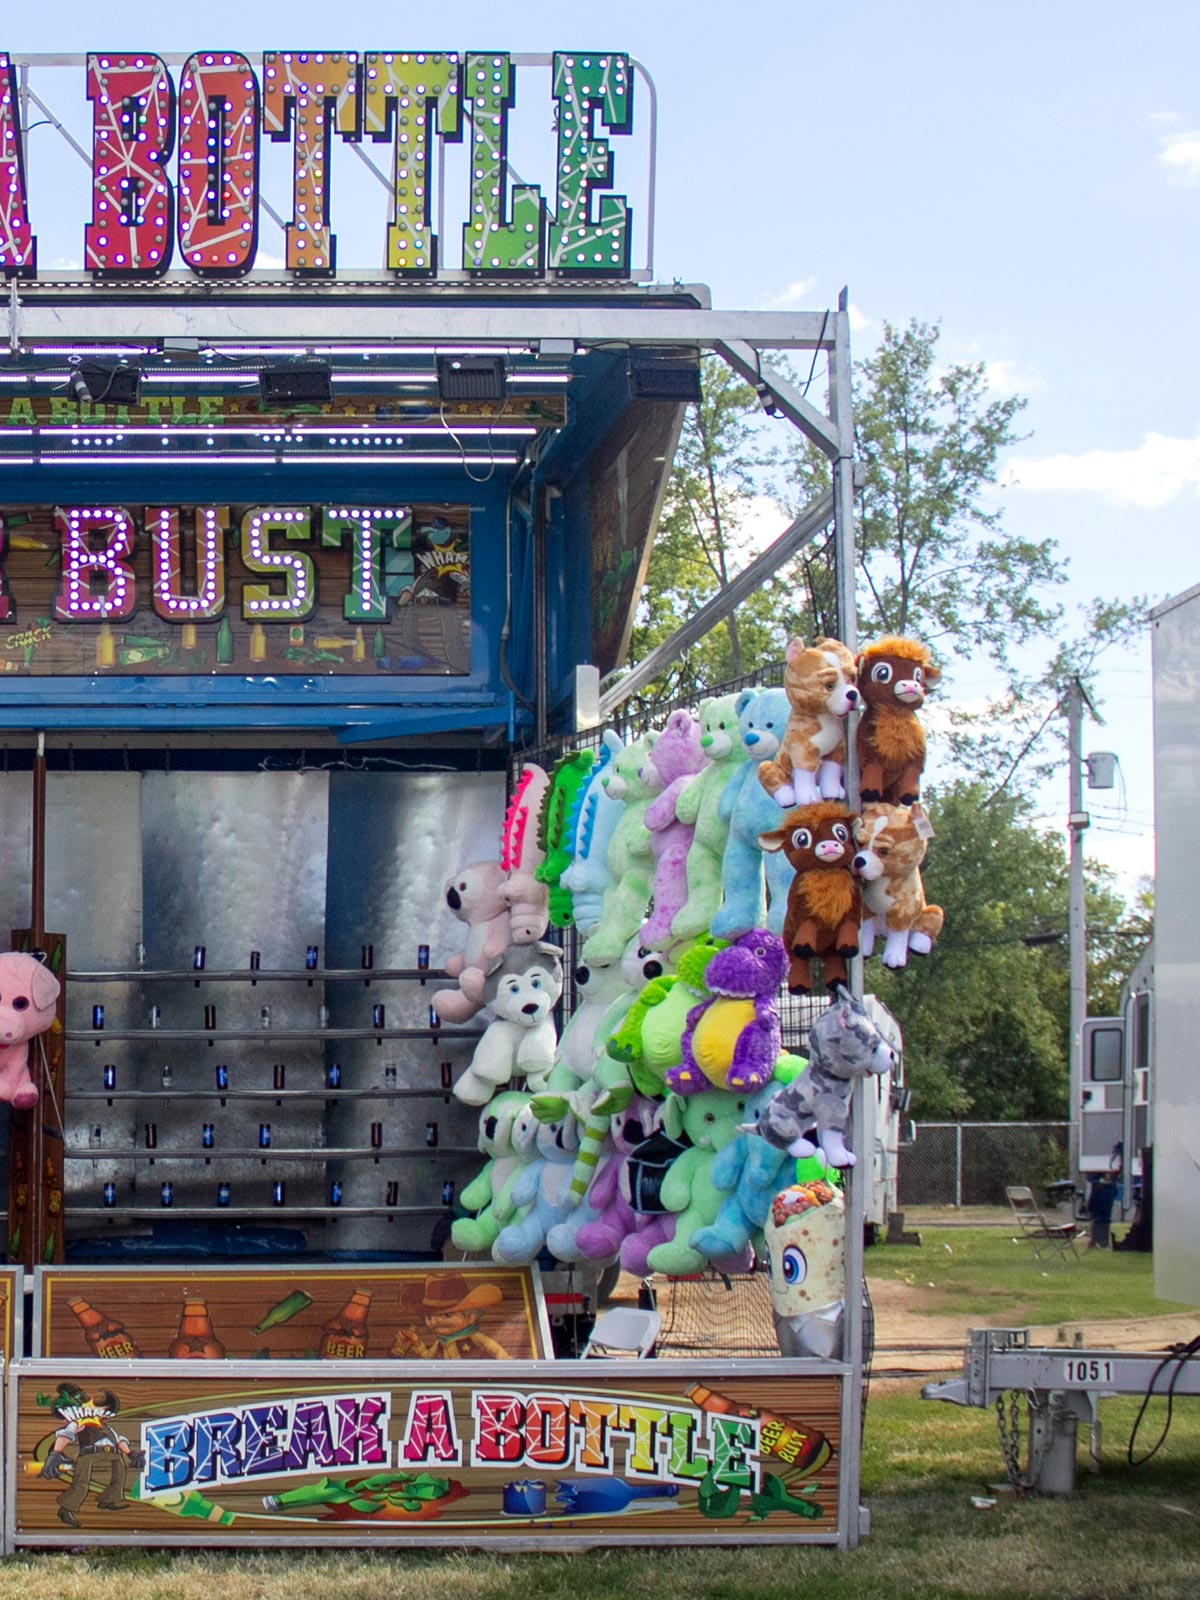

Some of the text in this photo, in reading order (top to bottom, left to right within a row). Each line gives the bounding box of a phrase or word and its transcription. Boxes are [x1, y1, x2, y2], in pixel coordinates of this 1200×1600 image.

[86, 51, 633, 279] BOTTLE
[7, 398, 38, 425] A
[54, 505, 412, 624] BUST
[326, 1341, 365, 1358] BEER
[1067, 1361, 1110, 1381] 1051
[142, 1392, 758, 1496] BREAK A BOTTLE
[760, 1421, 785, 1455] BEER
[778, 1430, 808, 1464] BUST
